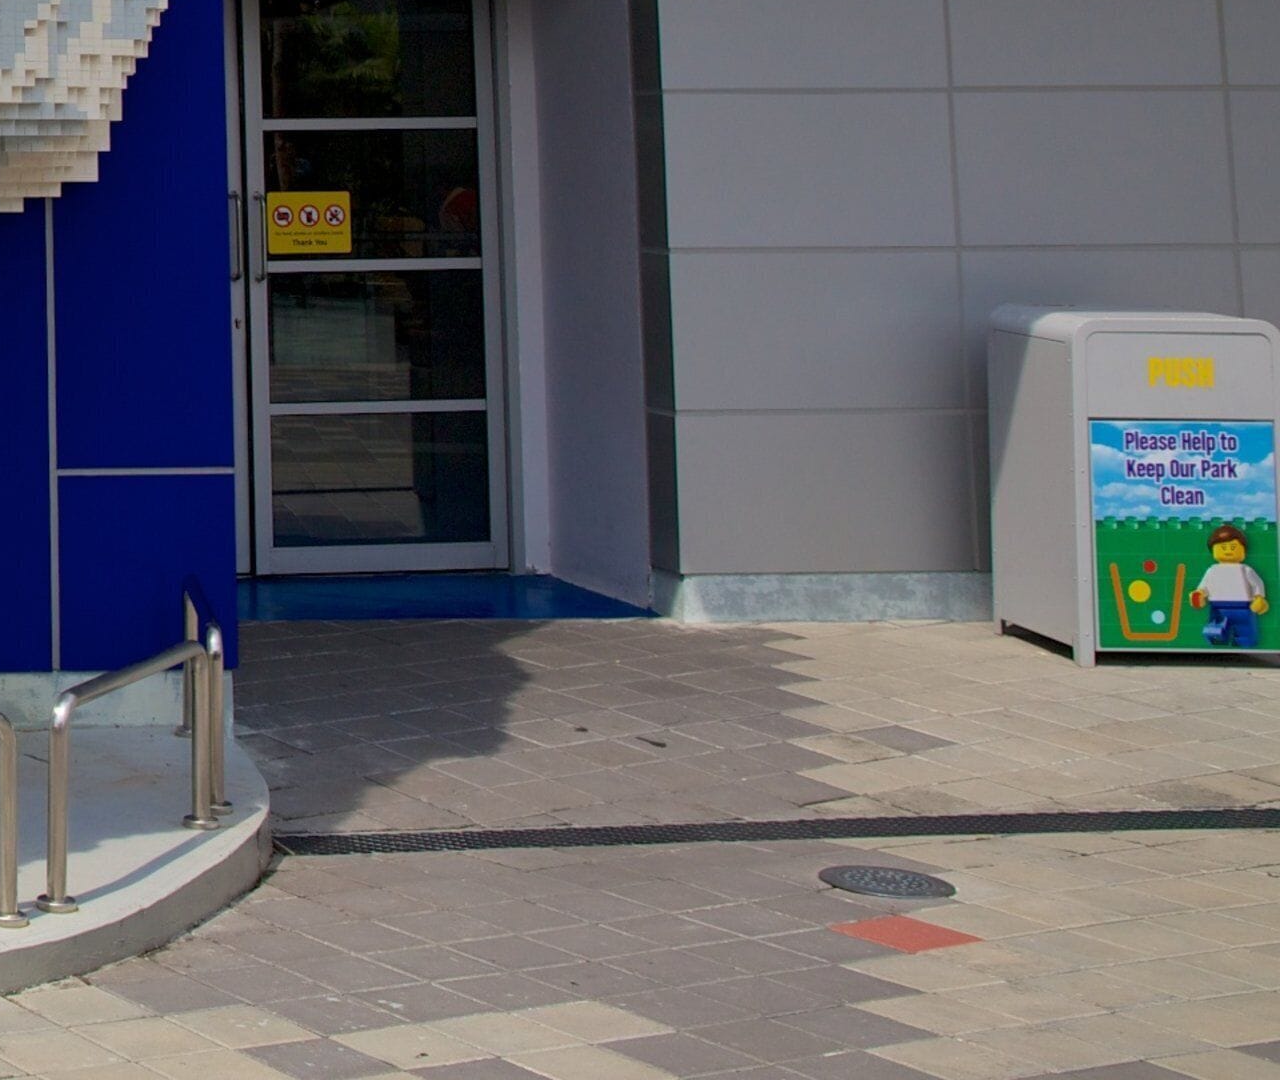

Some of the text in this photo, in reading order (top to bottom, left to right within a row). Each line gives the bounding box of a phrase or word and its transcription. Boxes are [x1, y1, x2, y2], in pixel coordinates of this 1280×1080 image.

[1147, 357, 1215, 388] PUSH
[1124, 431, 1238, 456] Please Help to
[1126, 459, 1238, 482] Keep Our Park
[1161, 486, 1204, 506] Clean
